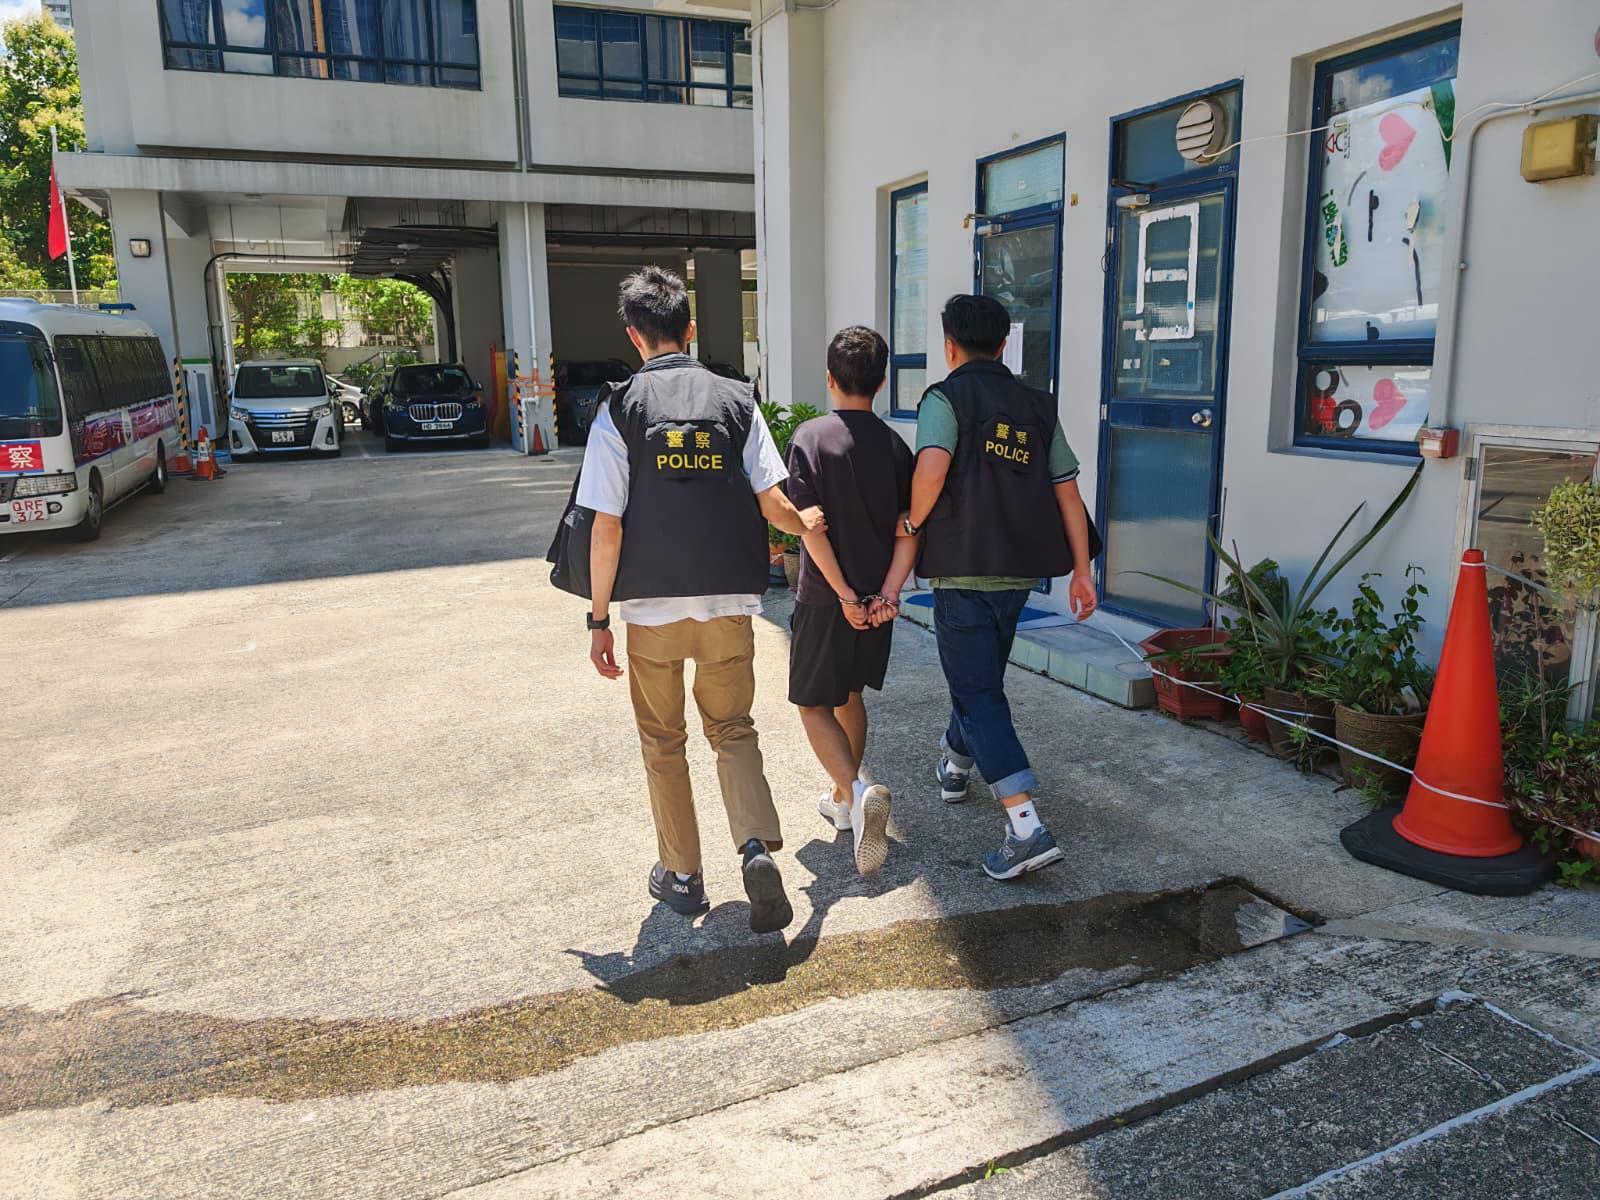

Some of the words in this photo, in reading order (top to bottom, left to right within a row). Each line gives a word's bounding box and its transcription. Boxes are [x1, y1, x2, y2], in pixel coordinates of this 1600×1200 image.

[666, 430, 711, 449] 警察
[8, 445, 34, 469] 察
[985, 440, 1030, 465] POLICE
[656, 454, 723, 470] POLICE
[12, 499, 43, 512] QRF
[671, 882, 689, 895] HOKA
